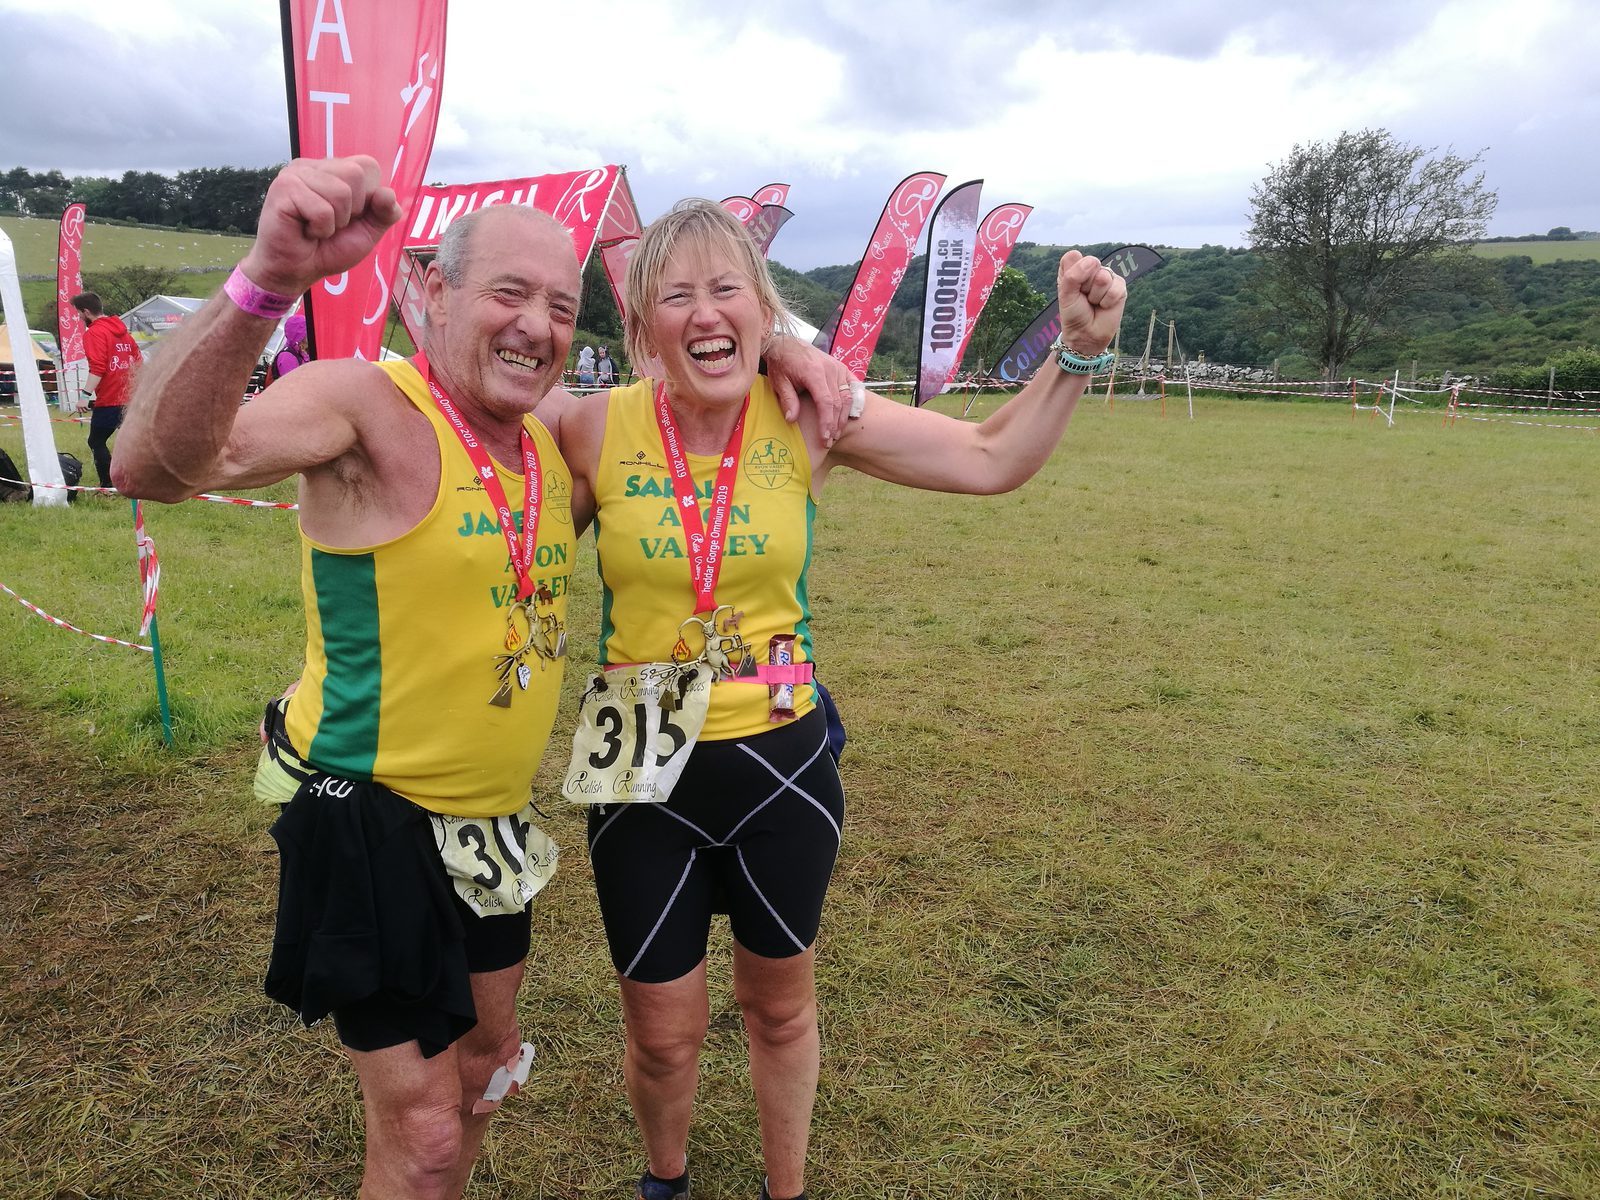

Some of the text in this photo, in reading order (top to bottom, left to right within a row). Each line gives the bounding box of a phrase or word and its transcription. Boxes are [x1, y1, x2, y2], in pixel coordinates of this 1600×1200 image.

[854, 266, 881, 303] Running
[930, 260, 962, 353] 1000th
[1000, 250, 1139, 381] Colou it
[460, 428, 478, 449] 2019
[666, 426, 680, 455] Omnium
[673, 453, 687, 479] 2019
[524, 451, 539, 566] Cheddar Gorge Omnium 2019
[701, 485, 728, 593] heddar Gorge Omnium 2019
[588, 703, 687, 770] 315
[567, 769, 657, 798] Relish Running
[463, 887, 504, 908] Relish
